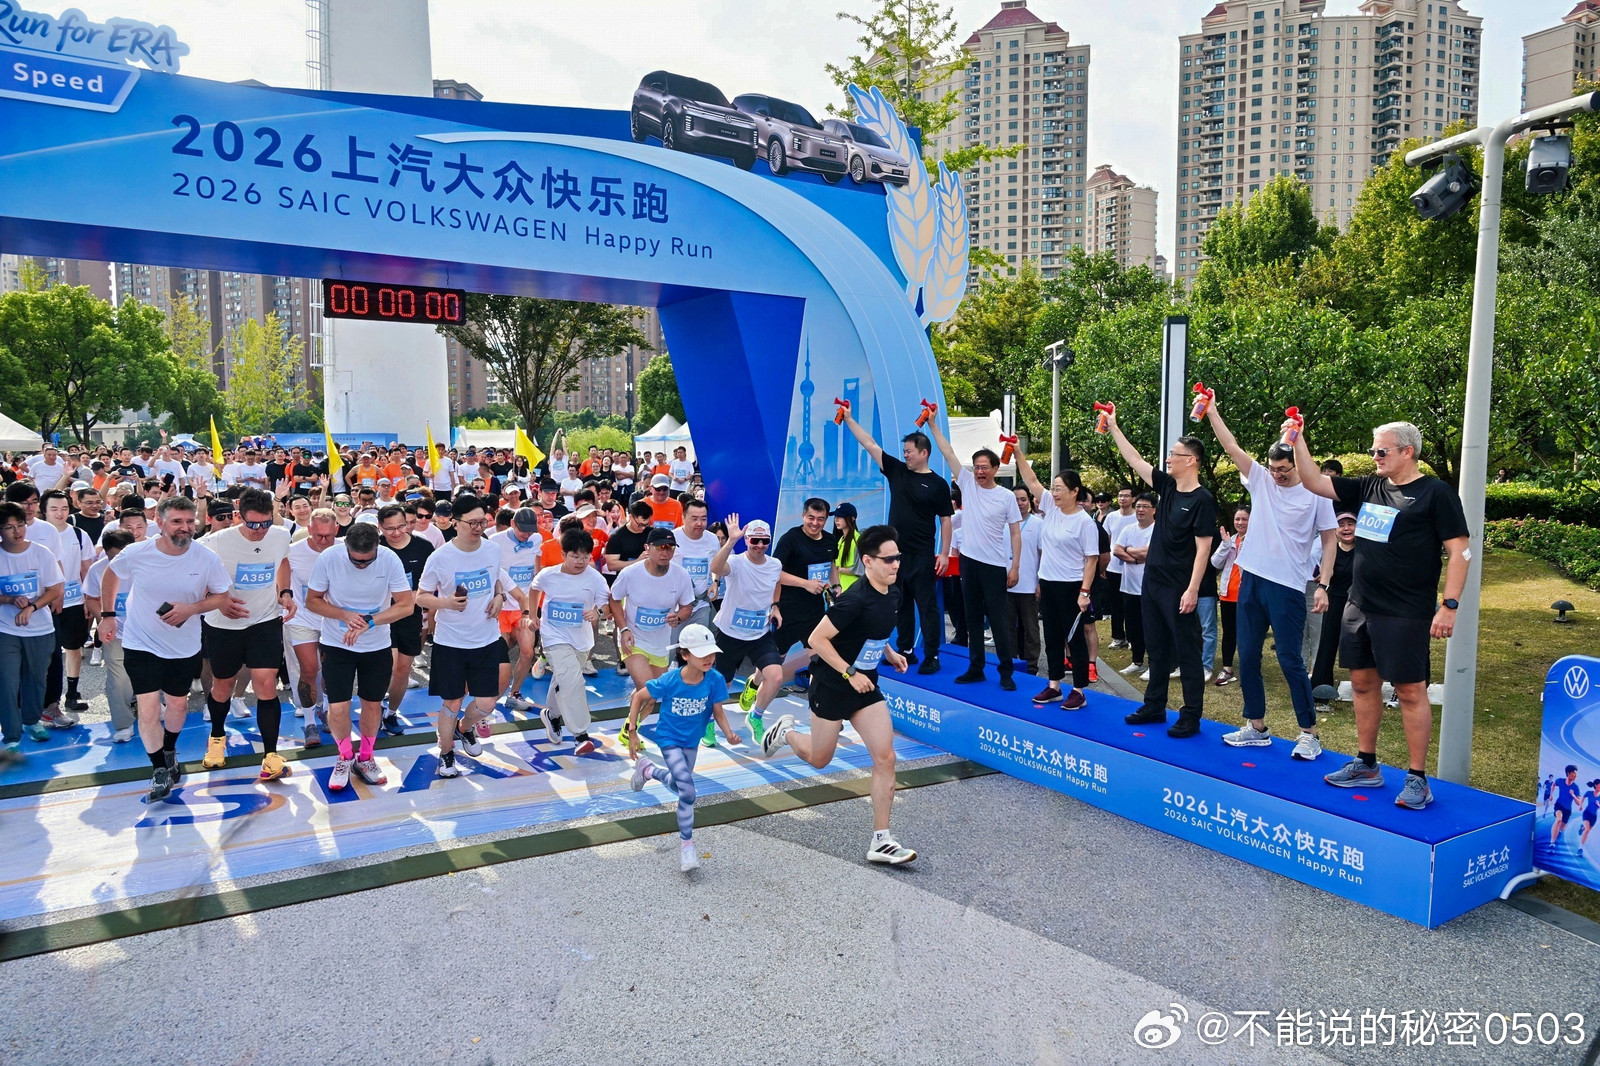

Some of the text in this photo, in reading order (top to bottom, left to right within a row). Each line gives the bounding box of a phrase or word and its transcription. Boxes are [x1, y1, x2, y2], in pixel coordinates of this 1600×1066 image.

[55, 14, 104, 52] for
[107, 24, 178, 66] ERA
[13, 62, 104, 93] Speed
[171, 114, 669, 224] 2026上汽大众快乐跑
[173, 172, 713, 259] 2026 SAIC VOLKSWAGEN Happy Run
[330, 284, 459, 321] 00 00 00
[1358, 514, 1389, 530] A007
[240, 572, 272, 582] A359
[512, 572, 532, 581] A500
[686, 565, 706, 573] A508
[5, 582, 33, 593] B011
[461, 578, 488, 590] A099
[552, 609, 578, 620] B001
[640, 615, 666, 624] E006
[736, 617, 760, 627] A171
[863, 649, 884, 660] E00
[907, 715, 926, 729] Happy
[928, 722, 940, 732] Run
[979, 726, 1108, 784] 2026上汽大众快乐跑
[980, 742, 1107, 795] 2026 SAIC VOLKSWAGEN Happy Run
[1162, 787, 1365, 872] 2026上汽大众快乐跑
[1164, 807, 1363, 885] 2026 SAIC VOLKSWAGEN Happy Run
[1464, 845, 1510, 877] 上汽大众
[1463, 862, 1509, 888] SAIC VOLKSWAGEN
